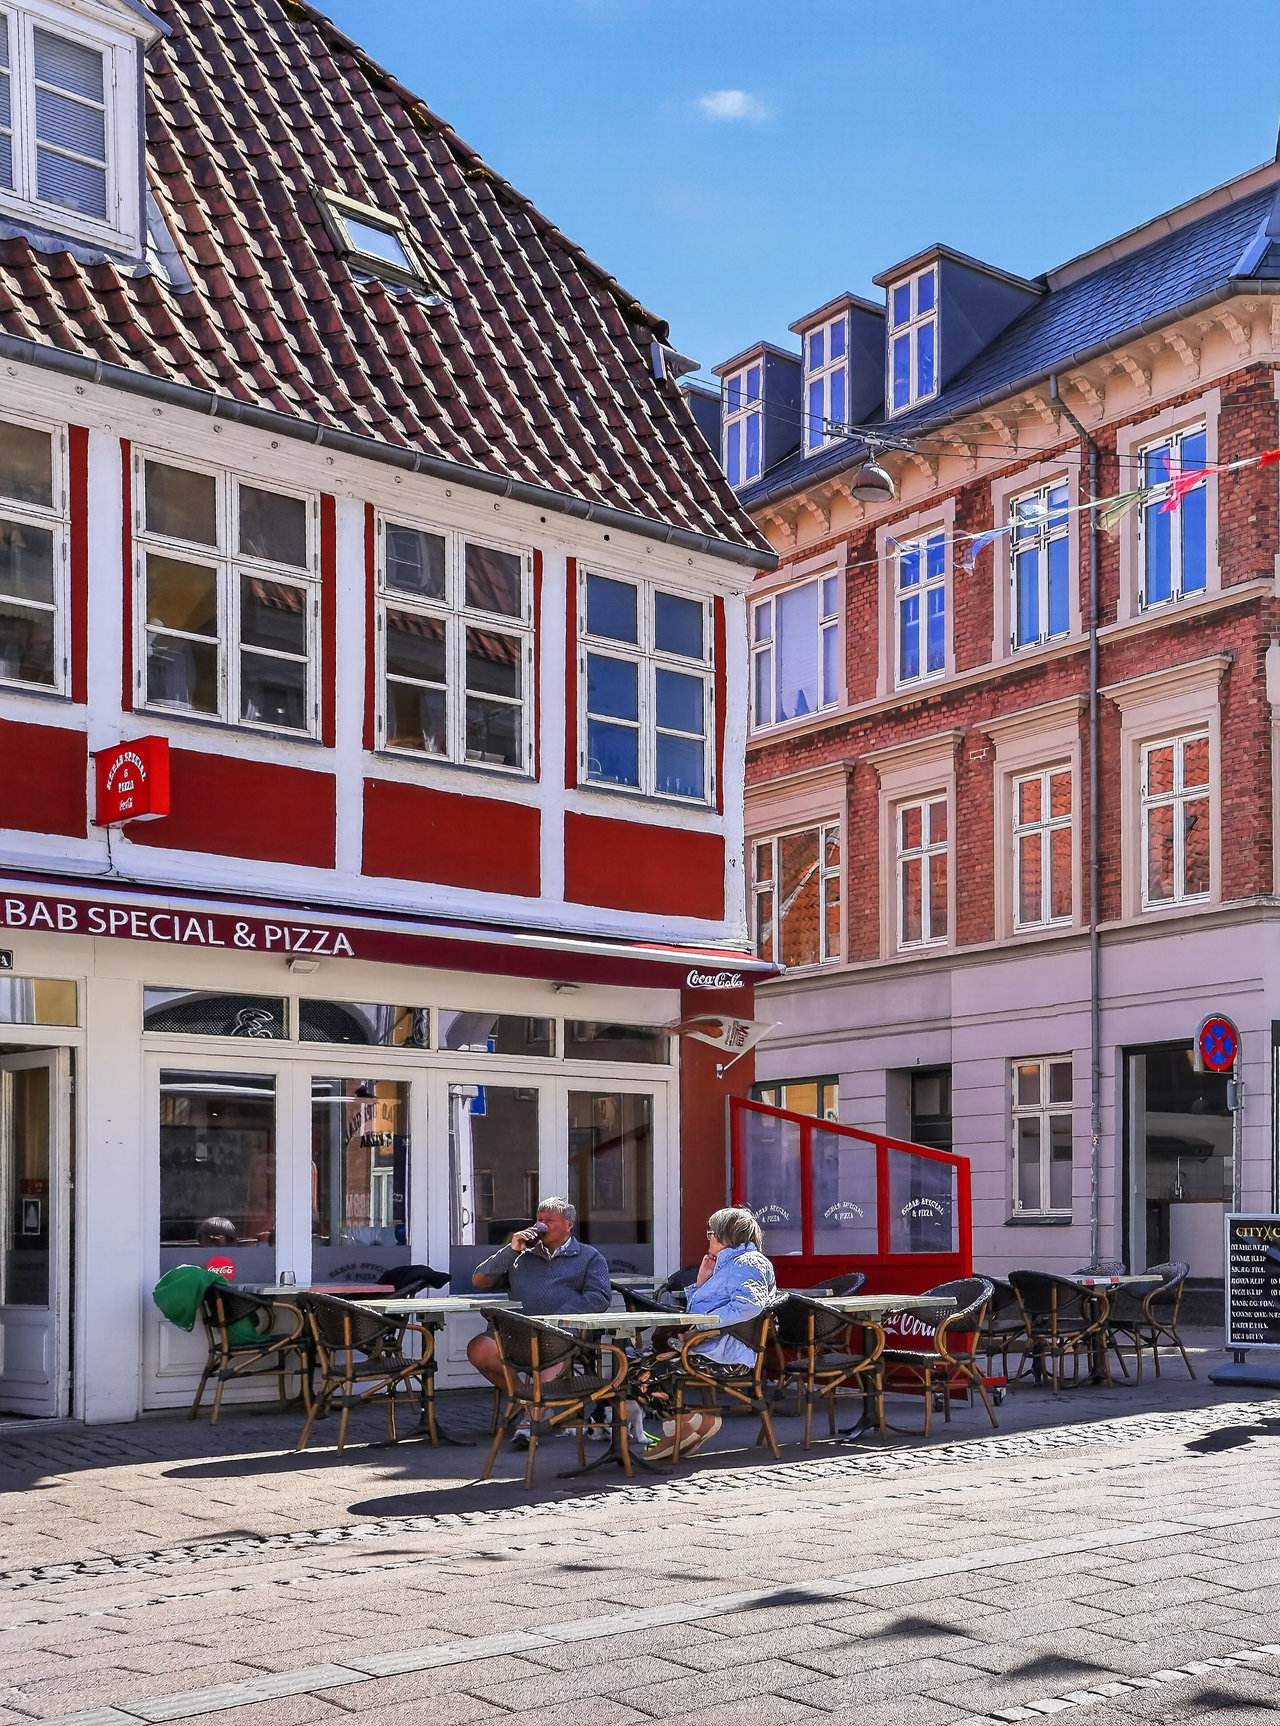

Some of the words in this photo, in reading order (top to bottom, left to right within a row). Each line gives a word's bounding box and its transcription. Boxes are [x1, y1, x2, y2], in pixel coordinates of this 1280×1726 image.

[0, 899, 78, 930] BAB
[88, 907, 225, 945] SPECIAL
[233, 922, 256, 948] &
[265, 925, 355, 956] PIZZA
[686, 969, 745, 989] Coca-Cola
[1235, 1226, 1264, 1238] CITY
